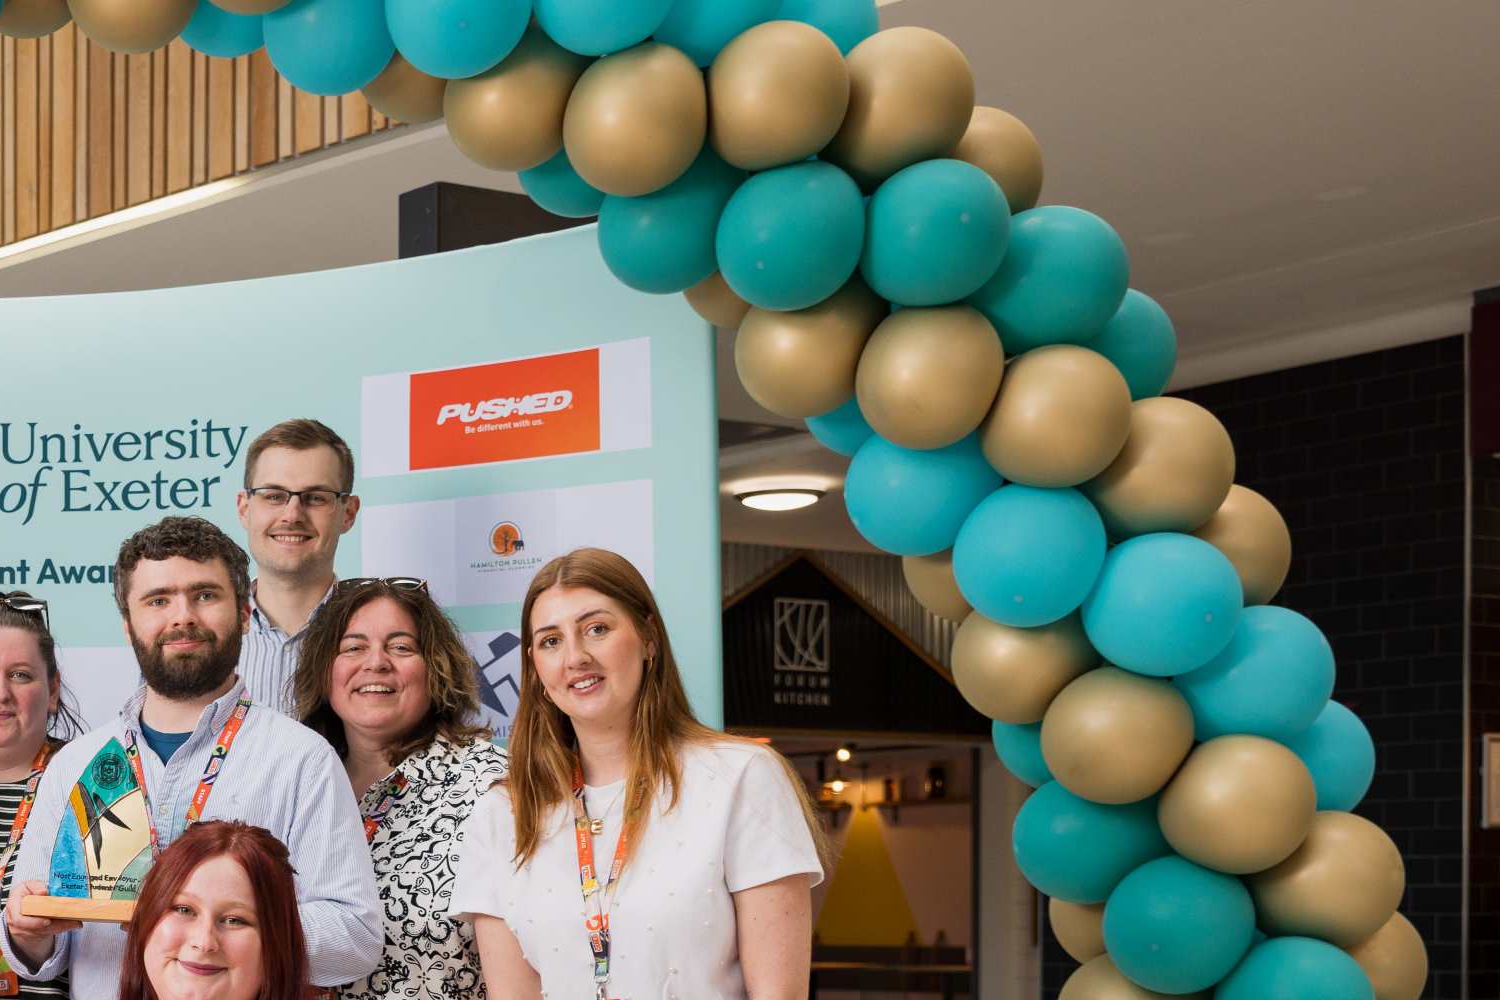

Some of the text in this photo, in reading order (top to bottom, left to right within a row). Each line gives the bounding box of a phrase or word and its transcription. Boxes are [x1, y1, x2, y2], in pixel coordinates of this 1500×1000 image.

[437, 390, 572, 425] PUSHED
[465, 425, 475, 434] Be
[477, 421, 512, 433] different
[513, 419, 531, 429] with
[0, 419, 248, 469] University
[61, 470, 221, 512] Exeter
